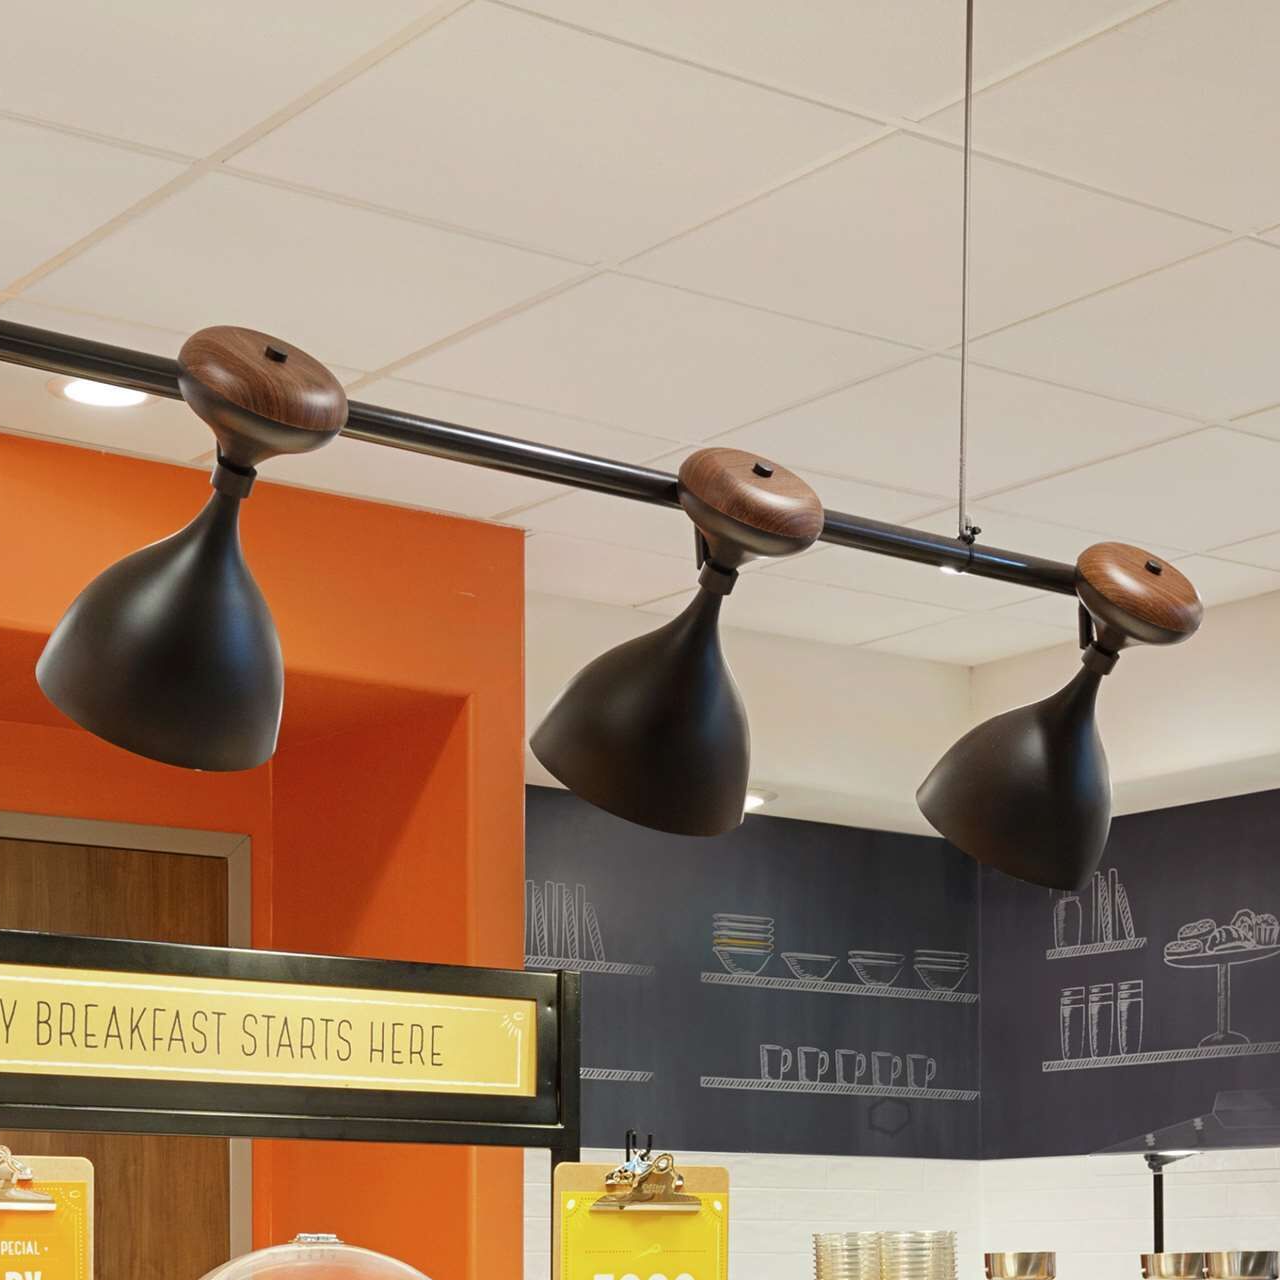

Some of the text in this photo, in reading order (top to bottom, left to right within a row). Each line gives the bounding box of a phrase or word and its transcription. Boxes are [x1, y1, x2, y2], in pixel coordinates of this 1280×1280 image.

[36, 1000, 227, 1055] BREAKFAST
[241, 1013, 352, 1062] STARTS
[369, 1021, 444, 1066] HERE
